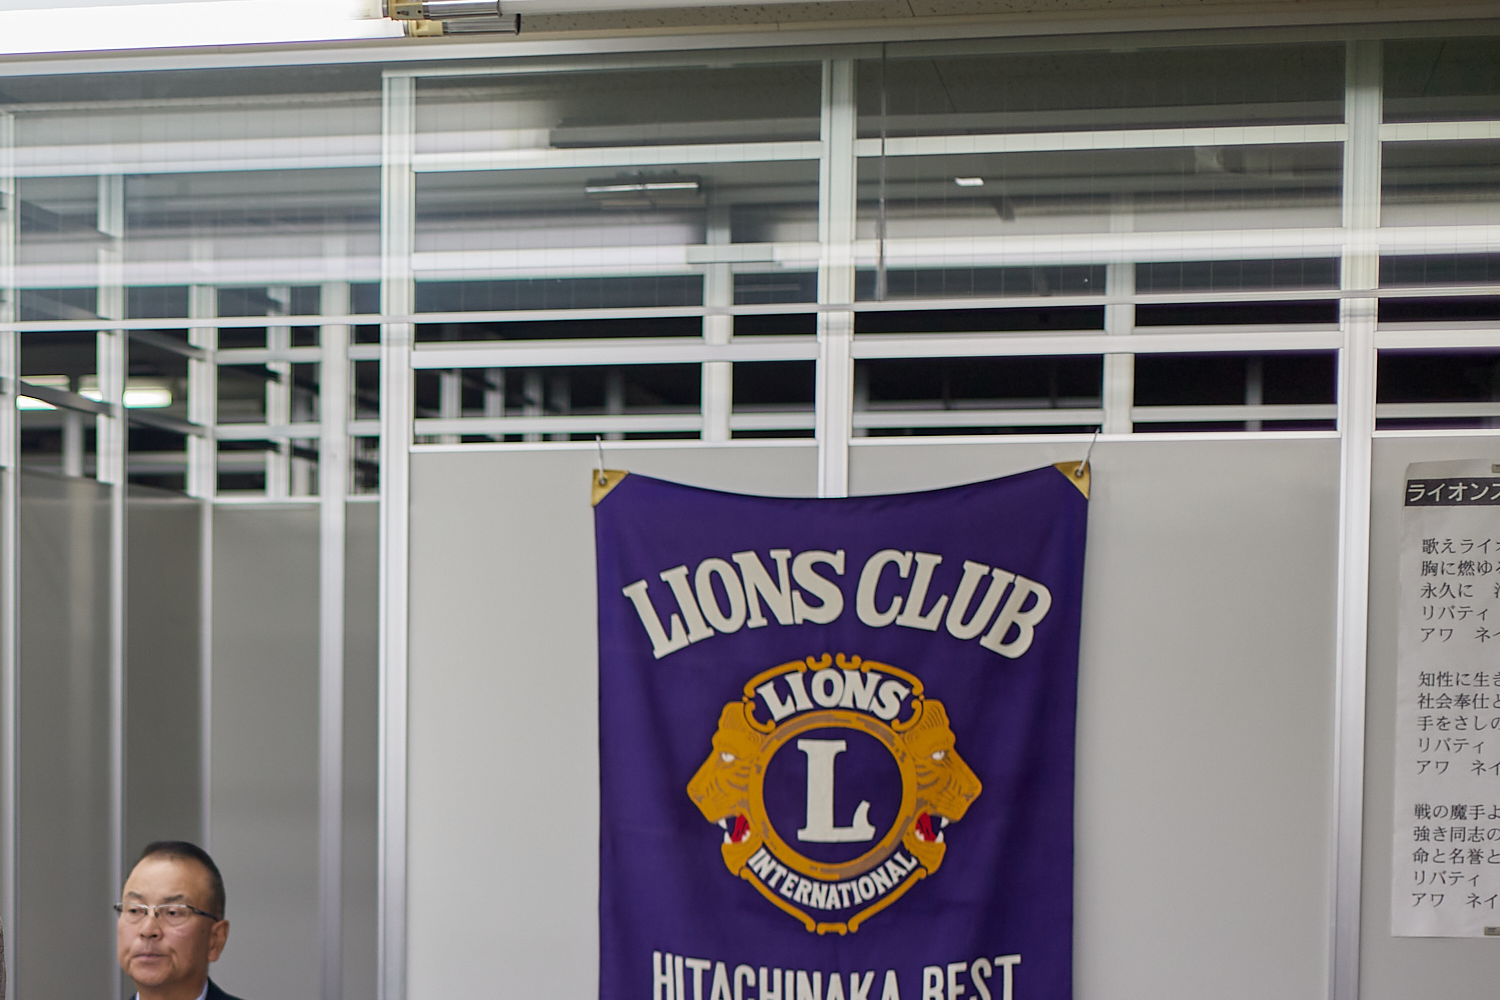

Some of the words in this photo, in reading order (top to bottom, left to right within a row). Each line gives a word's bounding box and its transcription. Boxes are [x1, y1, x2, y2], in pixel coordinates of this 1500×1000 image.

[1420, 582, 1474, 599] 永久に
[622, 548, 845, 659] LIONS
[855, 549, 1052, 659] CLUB
[1422, 604, 1489, 621] リバティ
[1420, 626, 1454, 643] アワ
[756, 668, 911, 721] LIONS
[1418, 737, 1485, 754] リバティ
[1416, 759, 1450, 776] アワ
[797, 738, 876, 843] L
[748, 848, 918, 910] INTERNATIONAL
[1414, 870, 1480, 887] リバティ
[1411, 892, 1446, 909] アワ
[1465, 892, 1499, 909] ネイ
